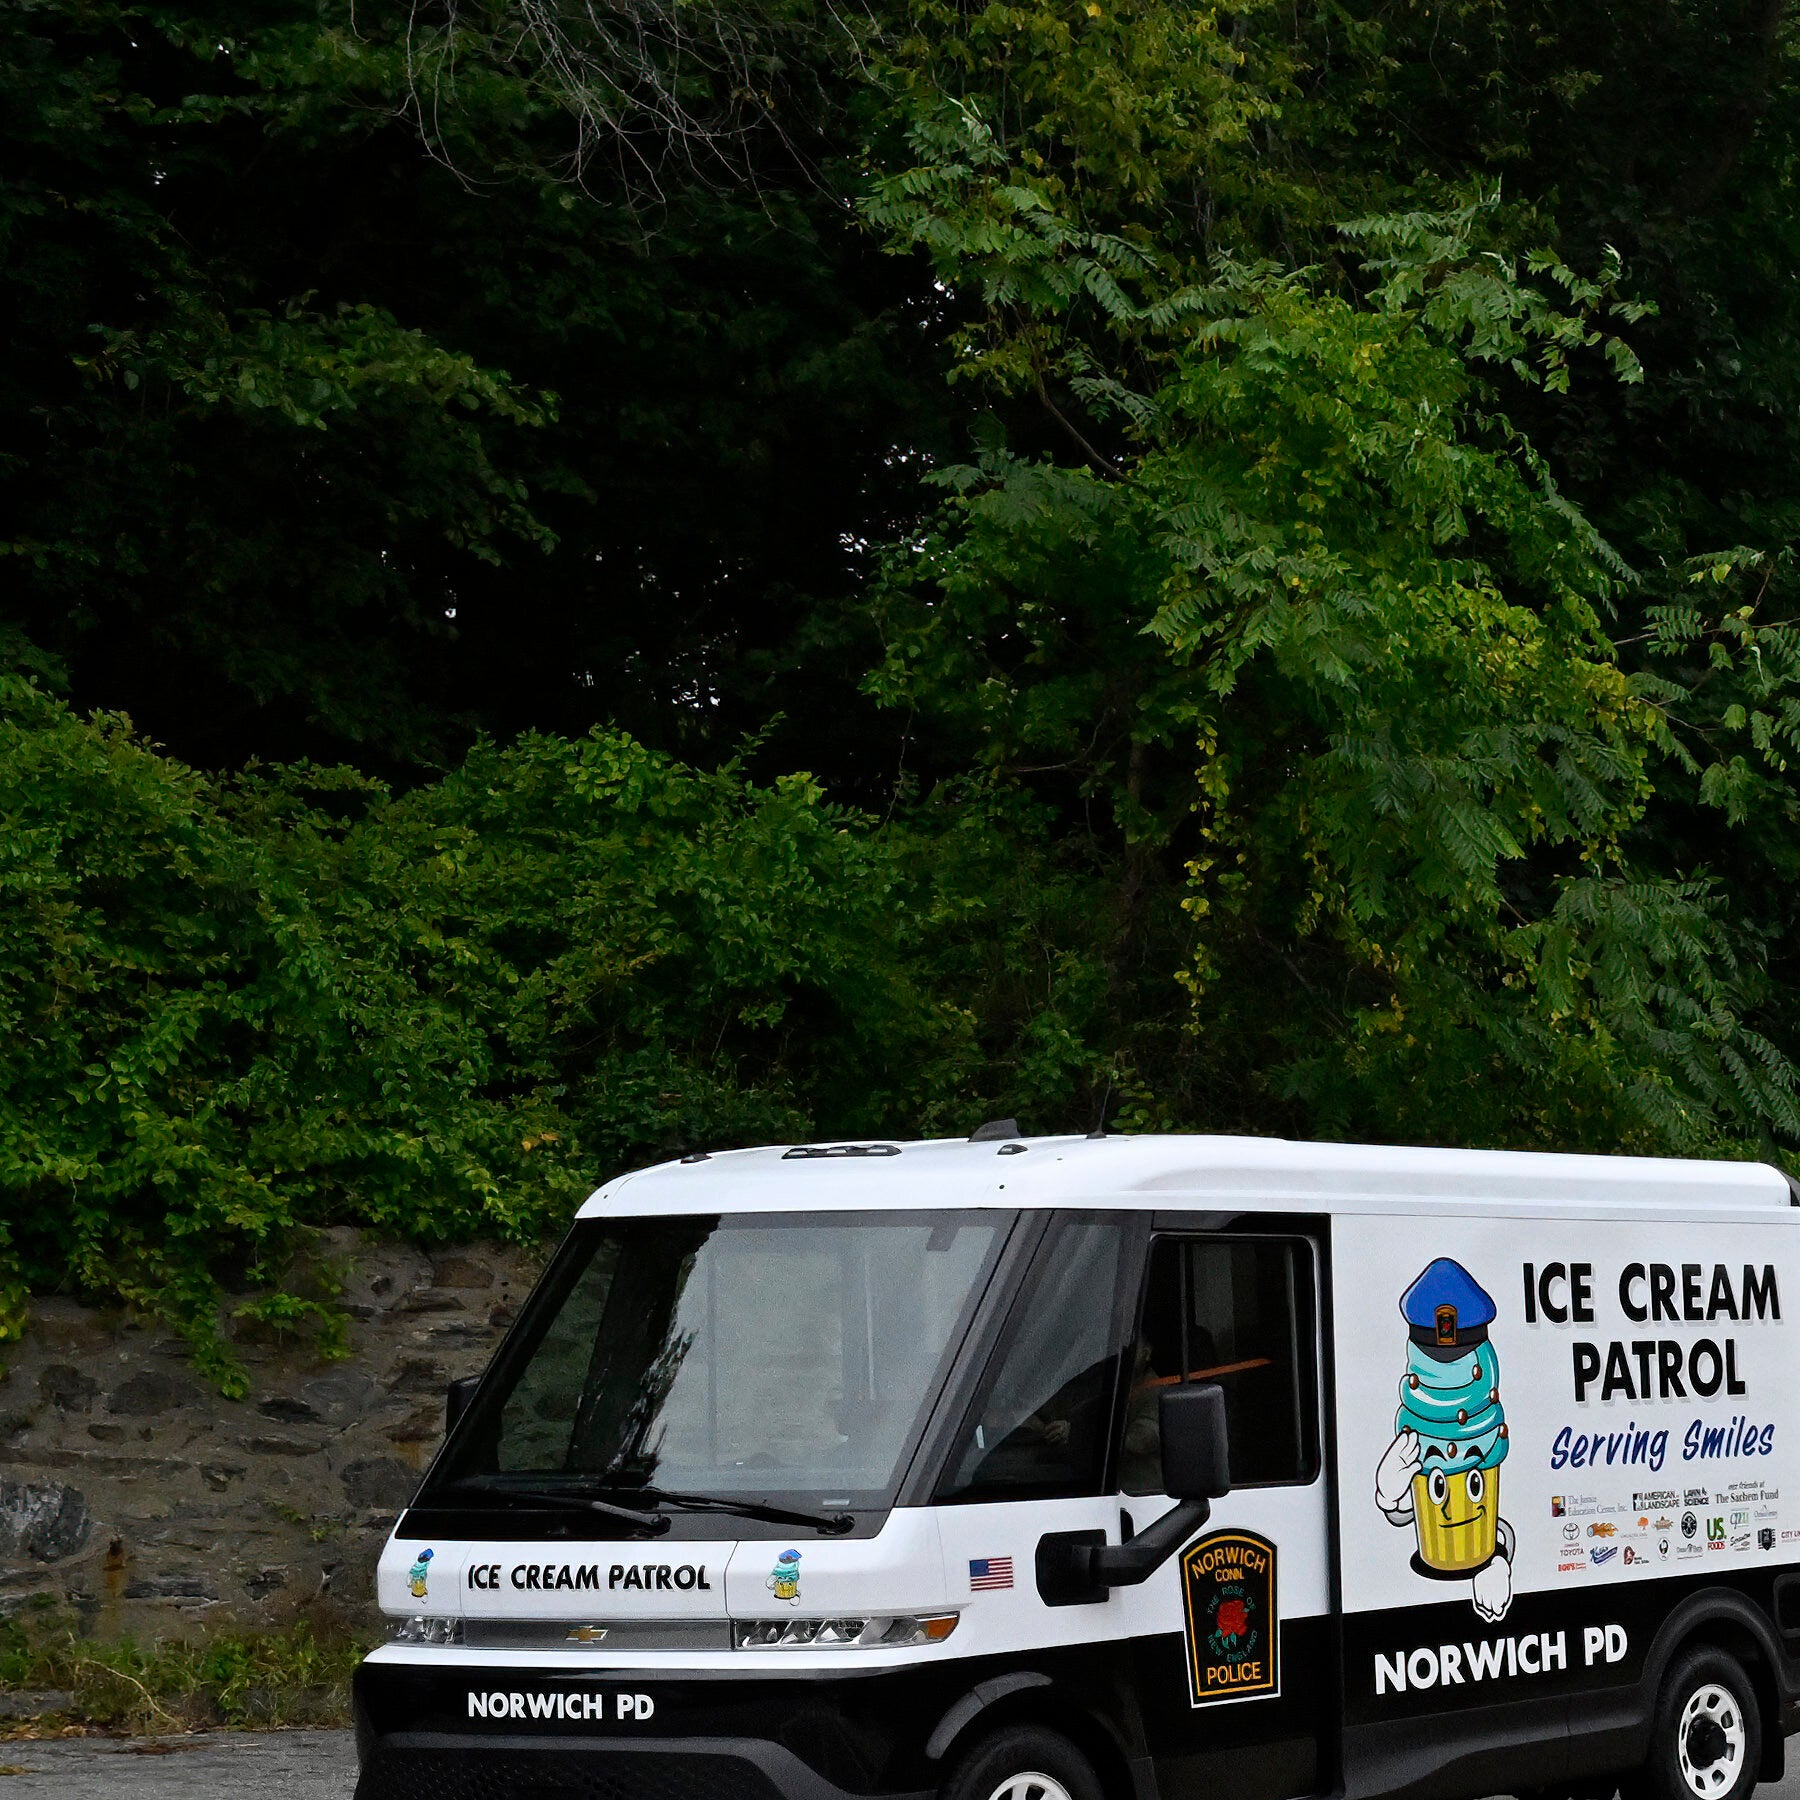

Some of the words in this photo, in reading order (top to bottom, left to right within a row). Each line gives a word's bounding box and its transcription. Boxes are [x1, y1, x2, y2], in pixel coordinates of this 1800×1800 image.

[1522, 1262, 1595, 1324] ICE
[1618, 1264, 1781, 1323] CREAM
[1572, 1338, 1746, 1402] PATROL
[1550, 1420, 1670, 1472] Serving
[1682, 1415, 1775, 1461] Smiles
[1684, 1496, 1709, 1506] SCIENCE
[1715, 1493, 1729, 1504] The
[1191, 1546, 1266, 1579] NORWICH
[1560, 1547, 1584, 1556] TOYOTA
[468, 1564, 499, 1590] ICE
[511, 1564, 599, 1590] CREAM
[609, 1564, 711, 1590] PATROL
[1222, 1585, 1245, 1598] ROSE
[1374, 1633, 1567, 1695] NORWICH
[1583, 1623, 1628, 1666] PD
[1206, 1662, 1261, 1685] POLICE
[468, 1692, 603, 1720] NORWICH
[617, 1694, 654, 1720] PD
